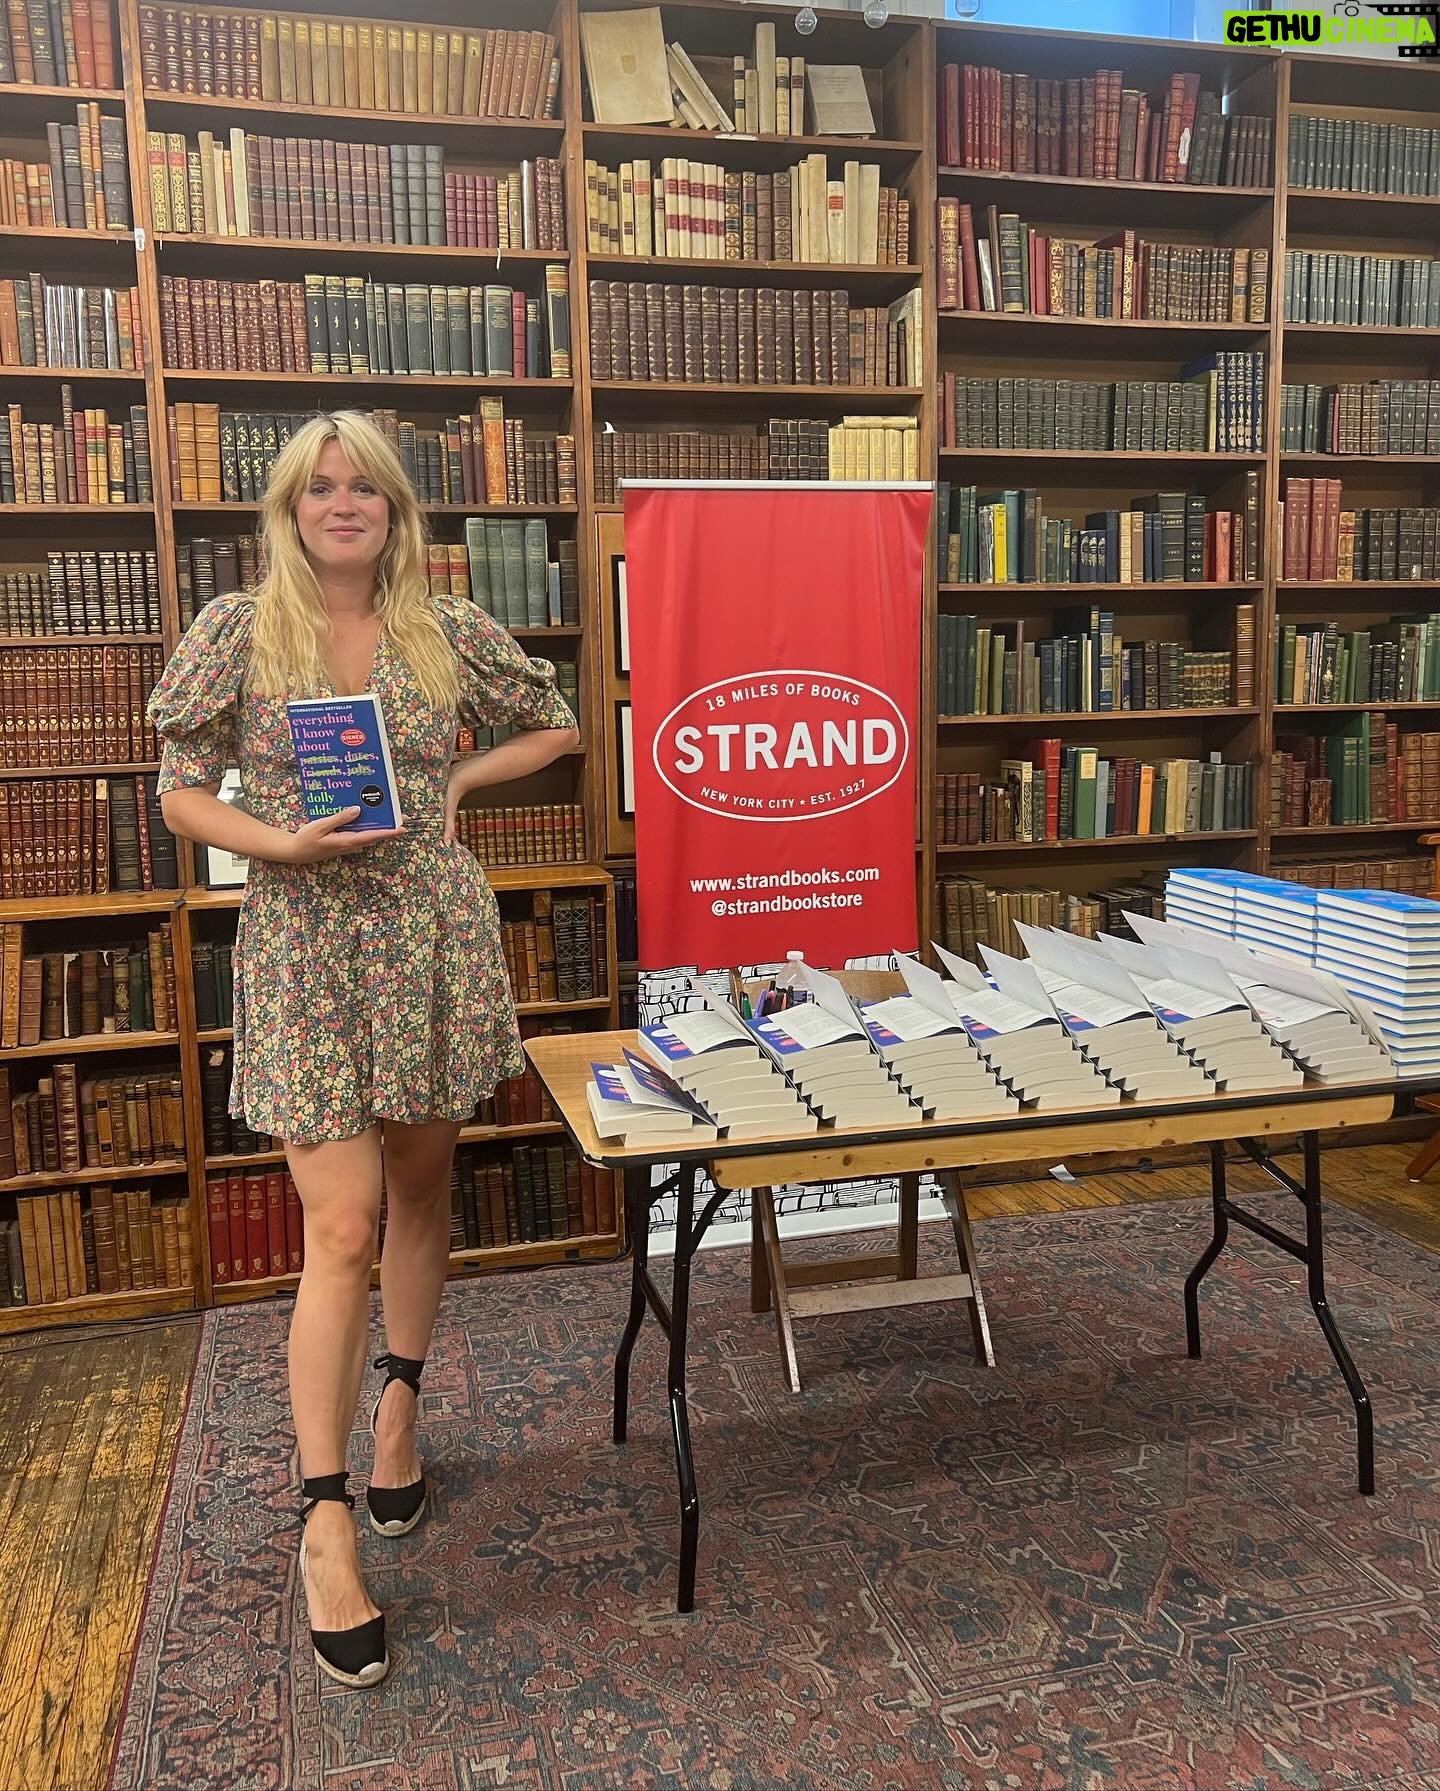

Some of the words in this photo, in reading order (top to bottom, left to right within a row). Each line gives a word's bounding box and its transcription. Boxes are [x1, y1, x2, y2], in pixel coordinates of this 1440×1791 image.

[705, 695, 726, 711] 18
[731, 683, 779, 703] MILES
[785, 683, 805, 695] OF
[811, 684, 860, 706] BOOKS
[292, 713, 354, 726] everything
[294, 728, 300, 739] I
[303, 728, 336, 739] know
[297, 741, 331, 752] about
[674, 719, 897, 774] STRAND
[327, 778, 352, 789] love
[307, 792, 335, 803] dolly
[700, 786, 729, 803] NEW
[732, 795, 764, 808] YORK
[768, 798, 795, 809] CITY
[810, 791, 836, 805] EST.
[839, 778, 866, 797] 1927
[690, 867, 880, 892] www.strandbooks.com
[711, 893, 863, 916] @strandbookstore
